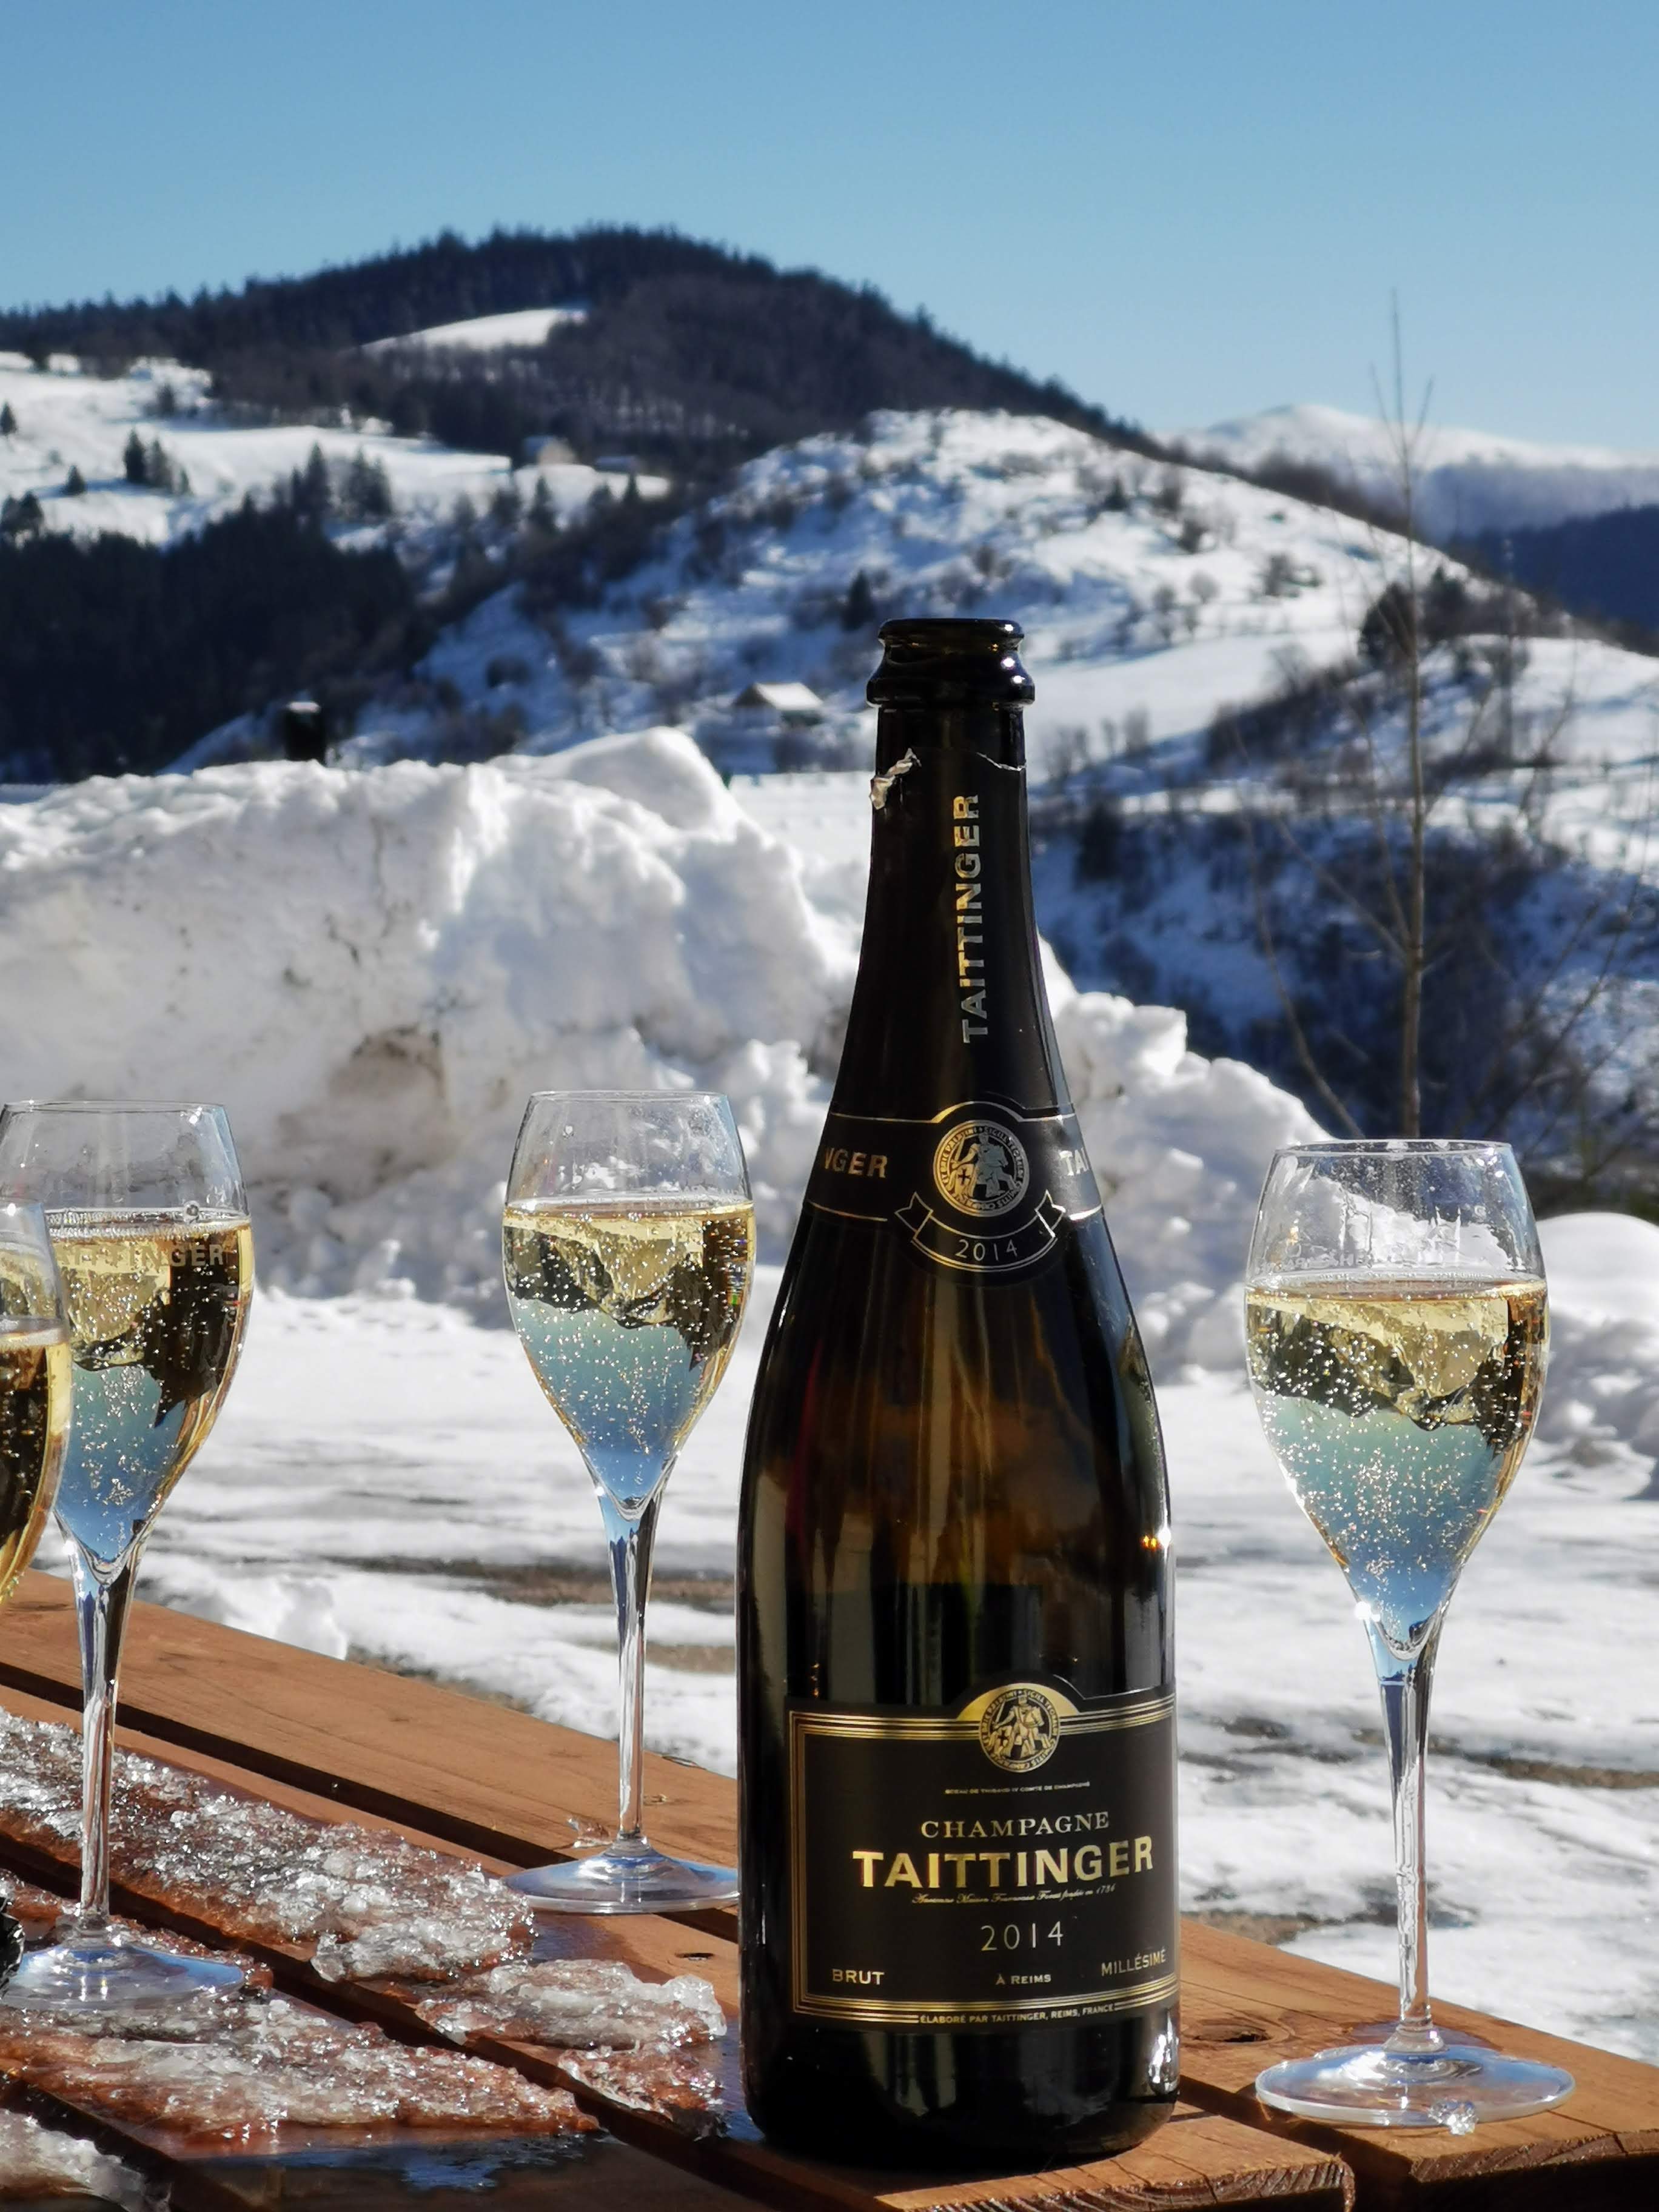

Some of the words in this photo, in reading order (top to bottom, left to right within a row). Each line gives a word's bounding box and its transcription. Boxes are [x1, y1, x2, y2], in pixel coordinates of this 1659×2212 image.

[953, 795, 988, 1043] TAITTINGER
[955, 1238, 1018, 1262] 2014
[920, 1811, 1109, 1838] CHAMPAGNE
[852, 1835, 1153, 1888] TAITTINGER
[980, 1920, 1064, 1951] 2014
[1101, 1946, 1166, 1977] MILLÉSIMÉ
[831, 1968, 885, 1986] BRUT
[996, 1973, 1006, 1985] À
[1010, 1973, 1052, 1985] REIMS
[920, 2012, 967, 2024] ÉLABORÉ
[970, 2015, 988, 2024] PAR
[992, 2013, 1048, 2023] TAITTINGER,
[1051, 2008, 1081, 2020] REIMS,
[1082, 2003, 1114, 2016] FRANCE
